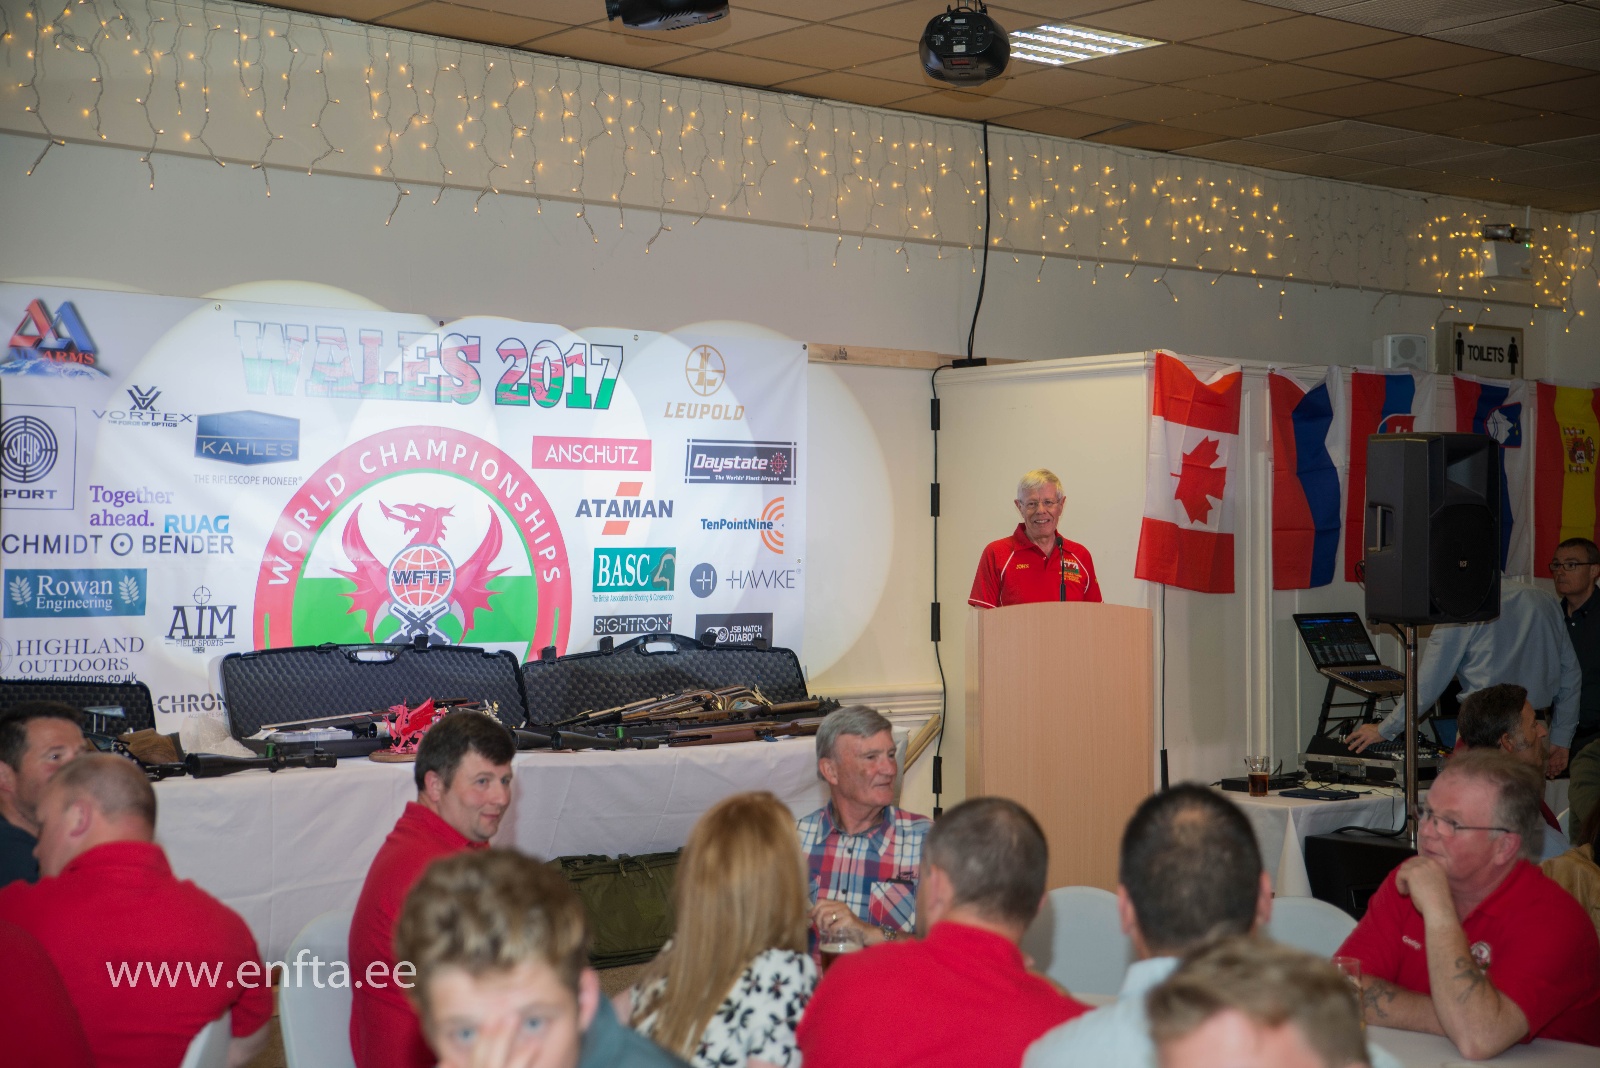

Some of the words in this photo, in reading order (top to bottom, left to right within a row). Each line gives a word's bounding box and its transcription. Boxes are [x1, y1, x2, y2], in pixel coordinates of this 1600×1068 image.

[42, 350, 95, 365] ARMS
[1468, 345, 1504, 363] TOILETS
[234, 320, 481, 405] WALES
[495, 337, 623, 410] 2017
[92, 409, 193, 423] VORTEX
[663, 401, 745, 421] LEUPOLD
[8, 433, 41, 466] STEYR
[202, 440, 293, 457] KAHLES
[693, 453, 768, 473] Daystate
[193, 474, 209, 484] THE
[212, 475, 260, 485] RIFLESCOPE
[262, 476, 298, 486] PIONEER
[0, 489, 58, 500] PORT
[89, 485, 174, 508] Together
[89, 509, 155, 527] ahead.
[268, 472, 346, 586] WORLD
[359, 438, 561, 583] CHAMPIONSHIPS
[575, 499, 674, 518] ATAMAN
[164, 514, 230, 534] RUAG
[701, 517, 774, 530] TenPointNine
[142, 535, 235, 554] BENDER
[392, 570, 451, 585] WFTF
[597, 553, 650, 587] BASC
[726, 569, 795, 590] HAWKE
[37, 575, 114, 596] Rowan
[36, 597, 113, 612] Engineering
[165, 605, 237, 640] AIM
[595, 616, 669, 633] SIGHTRON
[16, 637, 145, 656] HIGHLAND
[198, 639, 224, 647] SPORTS
[19, 657, 129, 673] OUTDOORS
